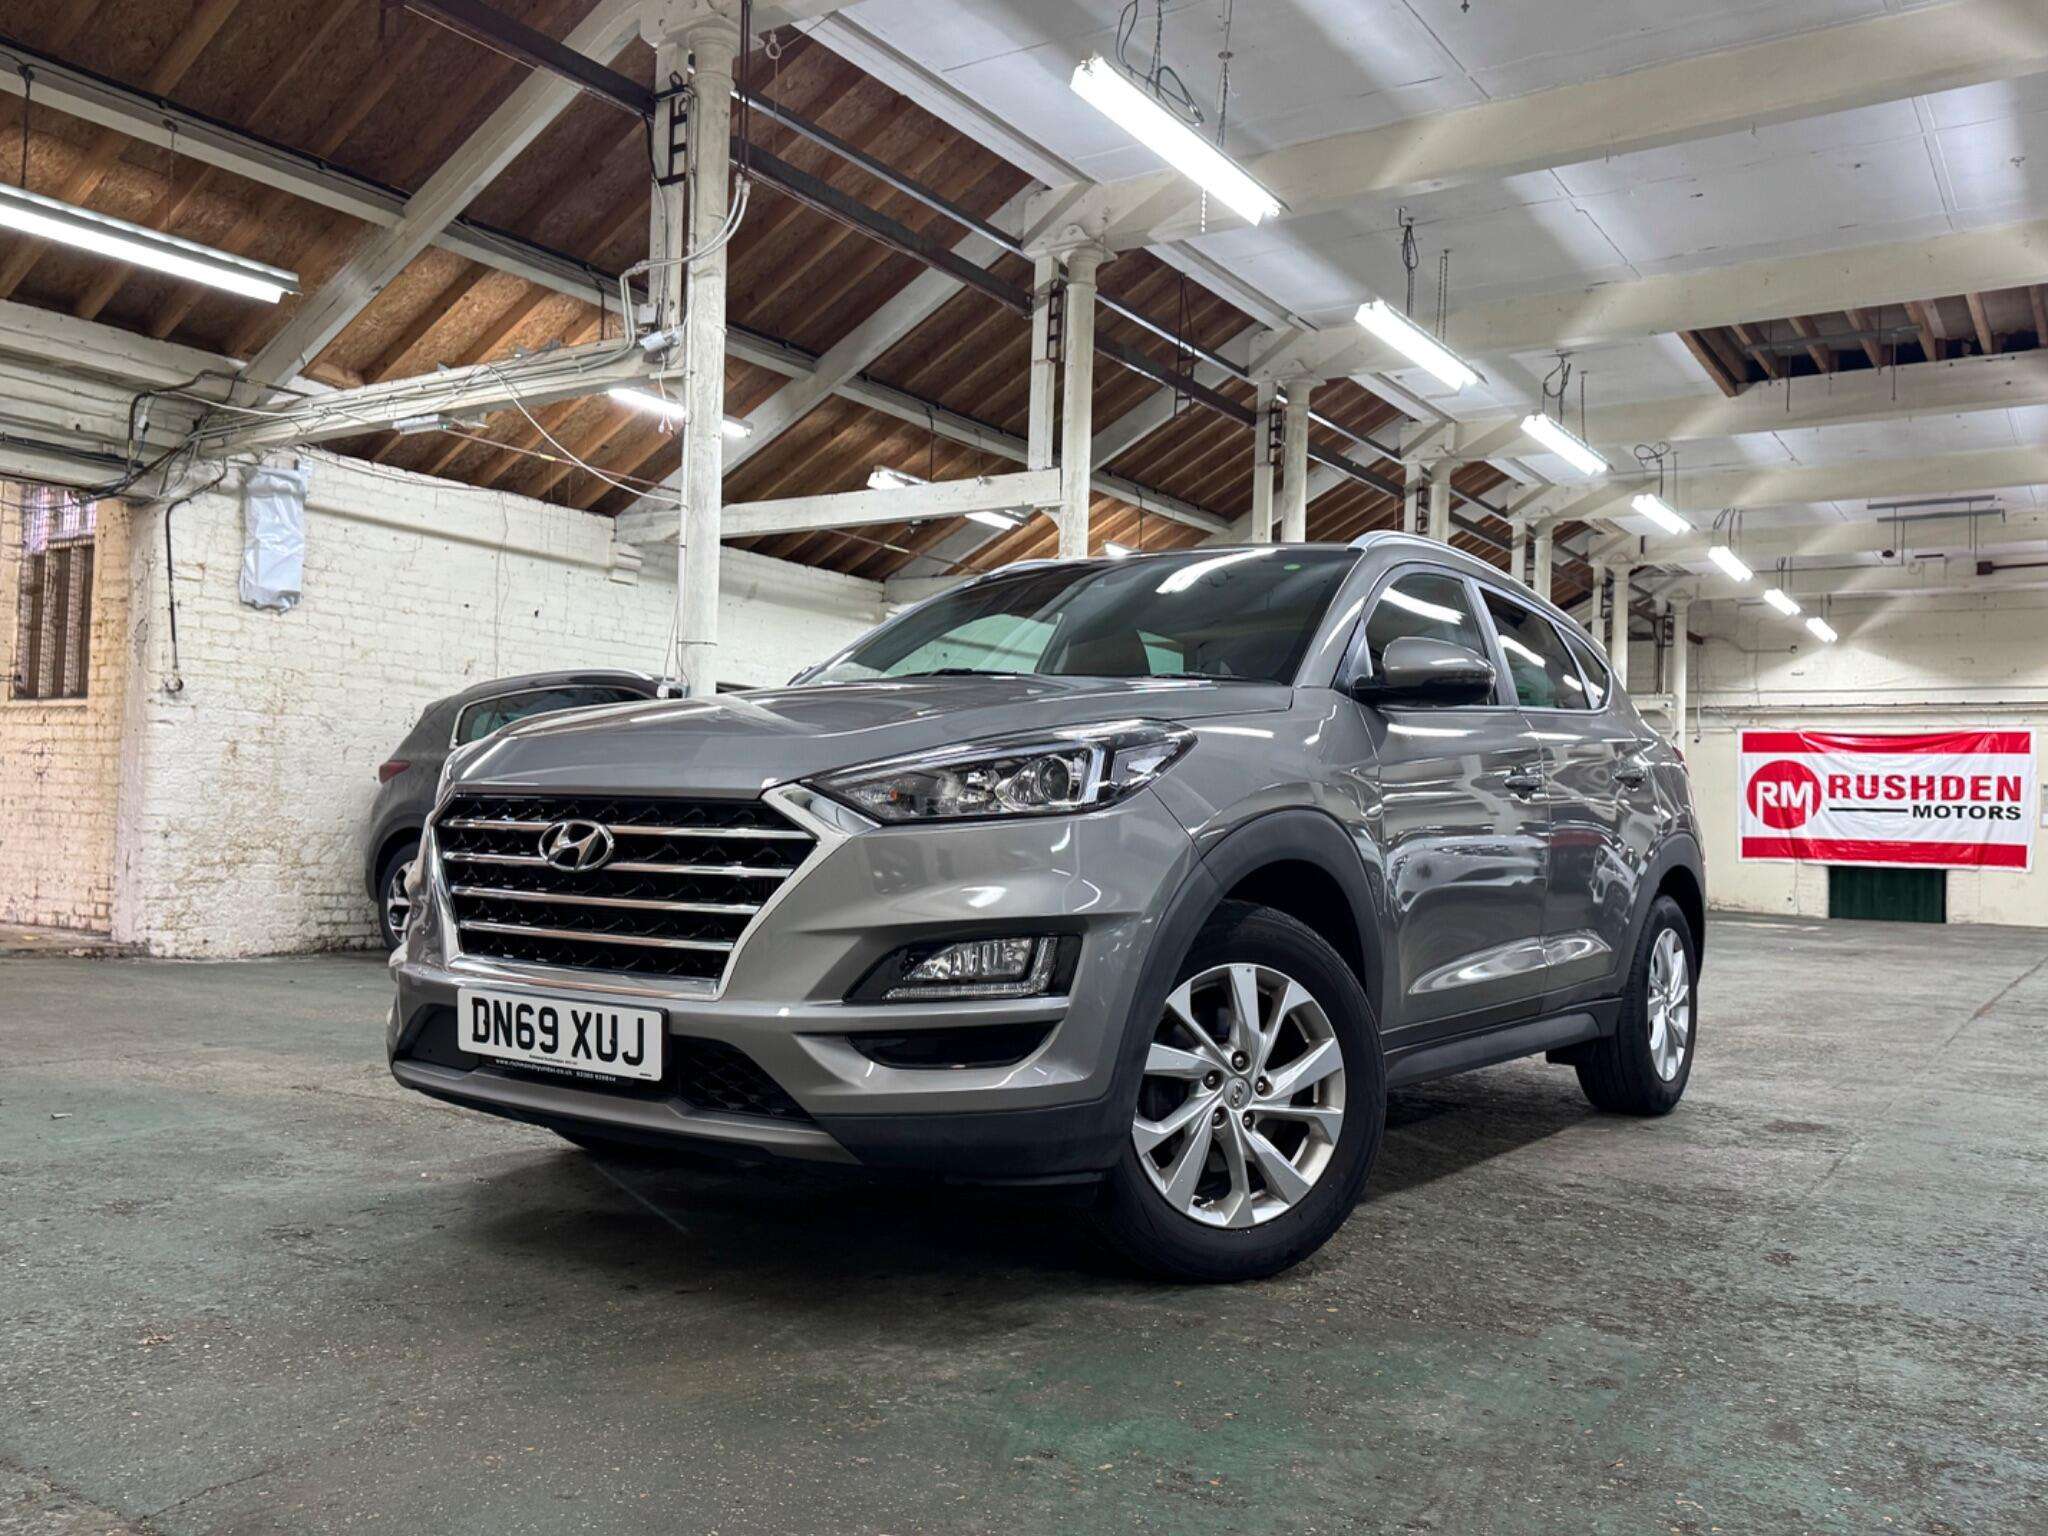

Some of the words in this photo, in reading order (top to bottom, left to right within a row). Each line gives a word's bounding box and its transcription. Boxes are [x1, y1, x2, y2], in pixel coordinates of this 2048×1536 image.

[1756, 780, 1814, 823] RM
[1827, 774, 2022, 802] RUSHDEN
[1912, 804, 2022, 821] MOTORS
[471, 997, 559, 1055] DN69
[570, 1010, 645, 1067] XUJ
